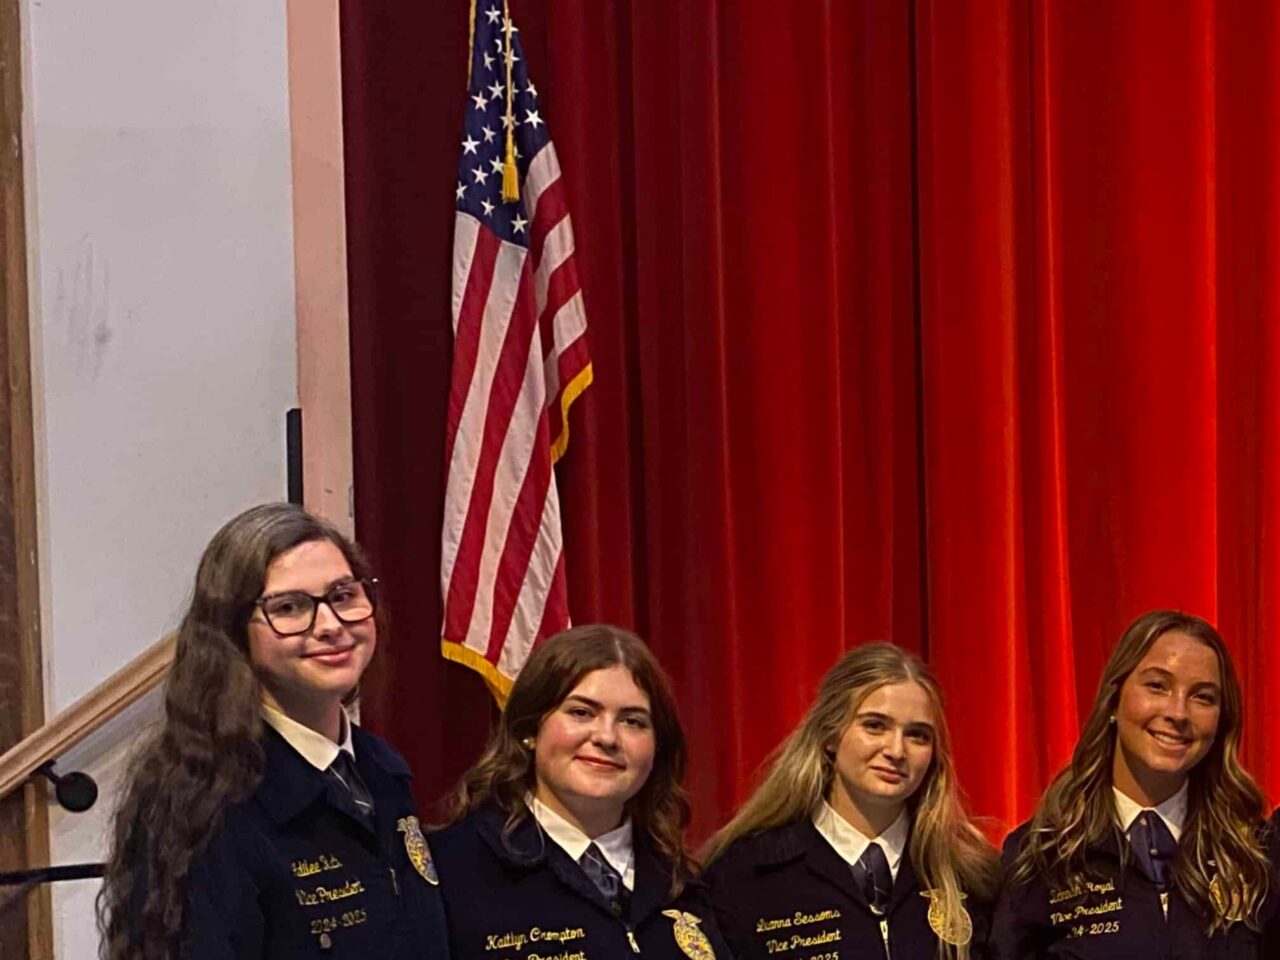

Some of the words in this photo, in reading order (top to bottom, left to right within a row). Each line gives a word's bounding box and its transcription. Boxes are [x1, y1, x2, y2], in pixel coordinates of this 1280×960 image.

[316, 878, 365, 902] President
[794, 910, 841, 925] Sessoms
[1074, 897, 1123, 918] President
[485, 932, 528, 950] Kaitlyn
[530, 927, 586, 944] Crompton
[766, 938, 788, 954] Vice
[790, 929, 842, 949] President
